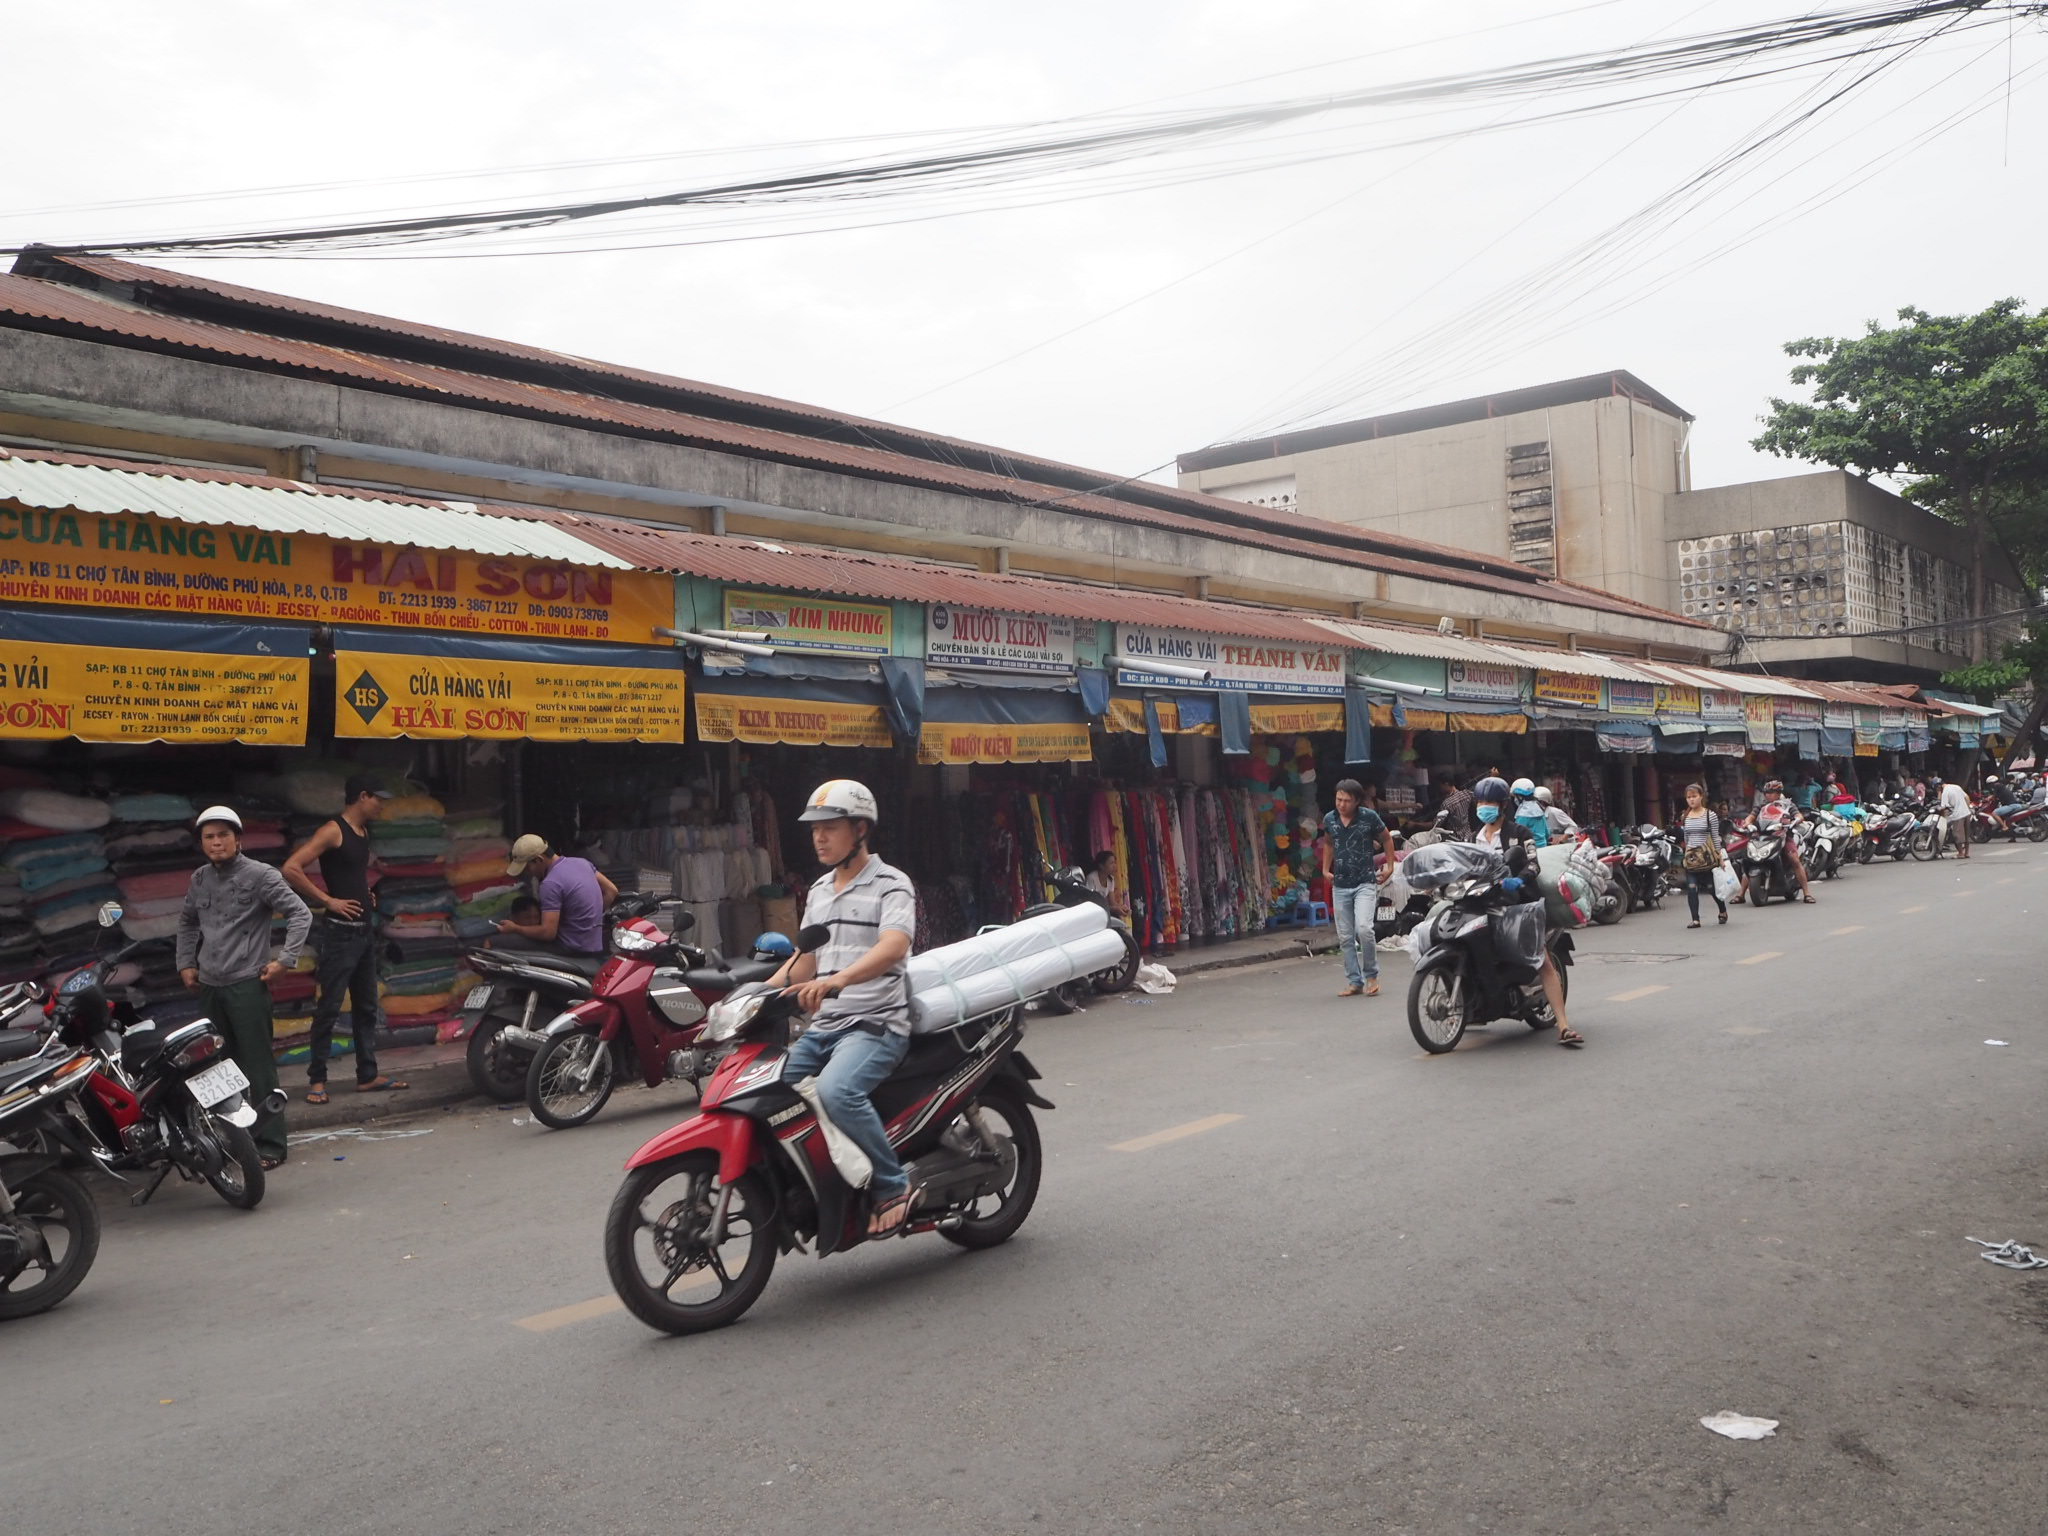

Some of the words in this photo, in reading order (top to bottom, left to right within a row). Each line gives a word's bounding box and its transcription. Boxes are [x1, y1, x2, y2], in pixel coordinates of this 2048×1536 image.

[98, 512, 216, 559] HÀNG
[29, 561, 51, 577] KB
[55, 564, 71, 579] 11
[76, 565, 107, 585] CHỢ
[112, 566, 140, 584] TÂN
[144, 568, 180, 590] BÌNH,
[184, 572, 229, 591] ĐƯỜNG
[233, 577, 259, 594] PHÚ
[262, 578, 290, 599] HÒA,
[320, 586, 347, 602] Q.TB
[475, 559, 613, 606] SƠN
[55, 585, 88, 602] KINH
[93, 588, 140, 605] DOANH
[145, 590, 172, 608] CÁC
[176, 594, 204, 612] MẶT
[208, 593, 243, 612] HÀNG
[276, 601, 320, 618] JECSEY
[331, 605, 381, 622] RAGIÔNG
[391, 611, 420, 625] THUN
[425, 610, 446, 627] BỐN
[489, 618, 528, 633] COTTON
[536, 621, 560, 635] THUN
[564, 624, 588, 639] LẠNH
[378, 591, 397, 605] ĐT:
[400, 593, 428, 608] 2213
[431, 595, 457, 609] 1939
[466, 598, 492, 612] 3867
[495, 601, 518, 615] 1217
[548, 604, 573, 619] 0903
[576, 607, 609, 622] 738769
[789, 606, 823, 630] KIM
[828, 609, 884, 635] NHUNG
[952, 610, 1001, 643] MƯỜI
[931, 642, 962, 654] CHUYÊN
[964, 643, 979, 655] BÁN
[991, 646, 996, 655] &
[1008, 647, 1021, 658] CÁC
[1024, 650, 1038, 661] LOẠI
[1052, 651, 1063, 663] SỢI
[1126, 630, 1153, 654] CỬA
[1158, 634, 1193, 658] HÀNG
[1197, 637, 1217, 660] VẢI
[1221, 645, 1297, 670] THANH
[1300, 648, 1341, 673] VÂN
[13, 655, 49, 690] VẢI
[85, 663, 109, 675] SẠP:
[113, 665, 127, 674] KB
[131, 666, 142, 675] 11
[146, 667, 167, 677] CHỢ
[170, 665, 189, 677] TÂN
[192, 667, 215, 678] BÌNH
[224, 670, 256, 681] ĐƯỜNG
[258, 671, 276, 681] PHÚ
[279, 671, 297, 682] HÒA
[410, 667, 439, 696] CỬA
[444, 672, 484, 699] HÀNG
[487, 672, 511, 700] VẢI
[535, 677, 551, 687] SẠP:
[553, 678, 563, 686] KB
[576, 679, 589, 688] CHỢ
[591, 679, 604, 687] TÂN
[126, 680, 132, 689] 8
[156, 682, 174, 692] TÂN
[178, 682, 200, 692] BÌNH
[229, 685, 274, 695] 38671217
[354, 688, 379, 707] HS
[0, 699, 70, 729] ƠN
[85, 694, 131, 706] CHUYÊN
[134, 696, 160, 707] KINH
[164, 698, 200, 708] DOANH
[252, 699, 278, 710] HÀNG
[282, 700, 298, 711] VẢI
[536, 702, 566, 711] CHUYÊN
[569, 703, 586, 712] KINH
[589, 705, 612, 713] DOANH
[613, 703, 628, 712] CÁC
[648, 704, 666, 714] HÀNG
[668, 704, 680, 714] VẢI
[83, 710, 113, 720] JECSEY
[121, 711, 149, 720] RAYON
[157, 712, 179, 722] THUN
[180, 713, 201, 723] LẠNH
[203, 711, 220, 723] BỐN
[254, 714, 284, 724] COTTON
[290, 716, 299, 725] PE
[391, 699, 454, 729] HẢI
[465, 705, 528, 732] SƠN
[535, 715, 555, 723] JECSEY
[650, 719, 670, 727] COTTON
[738, 709, 770, 728] KIM
[774, 711, 827, 731] NHUNG
[121, 725, 138, 733] ĐT:
[142, 725, 191, 734] 22131939
[202, 726, 268, 736] 0903.738.769
[661, 999, 703, 1013] HONDA
[194, 1065, 232, 1090] 59-V2
[767, 1102, 807, 1127] YAMAHA
